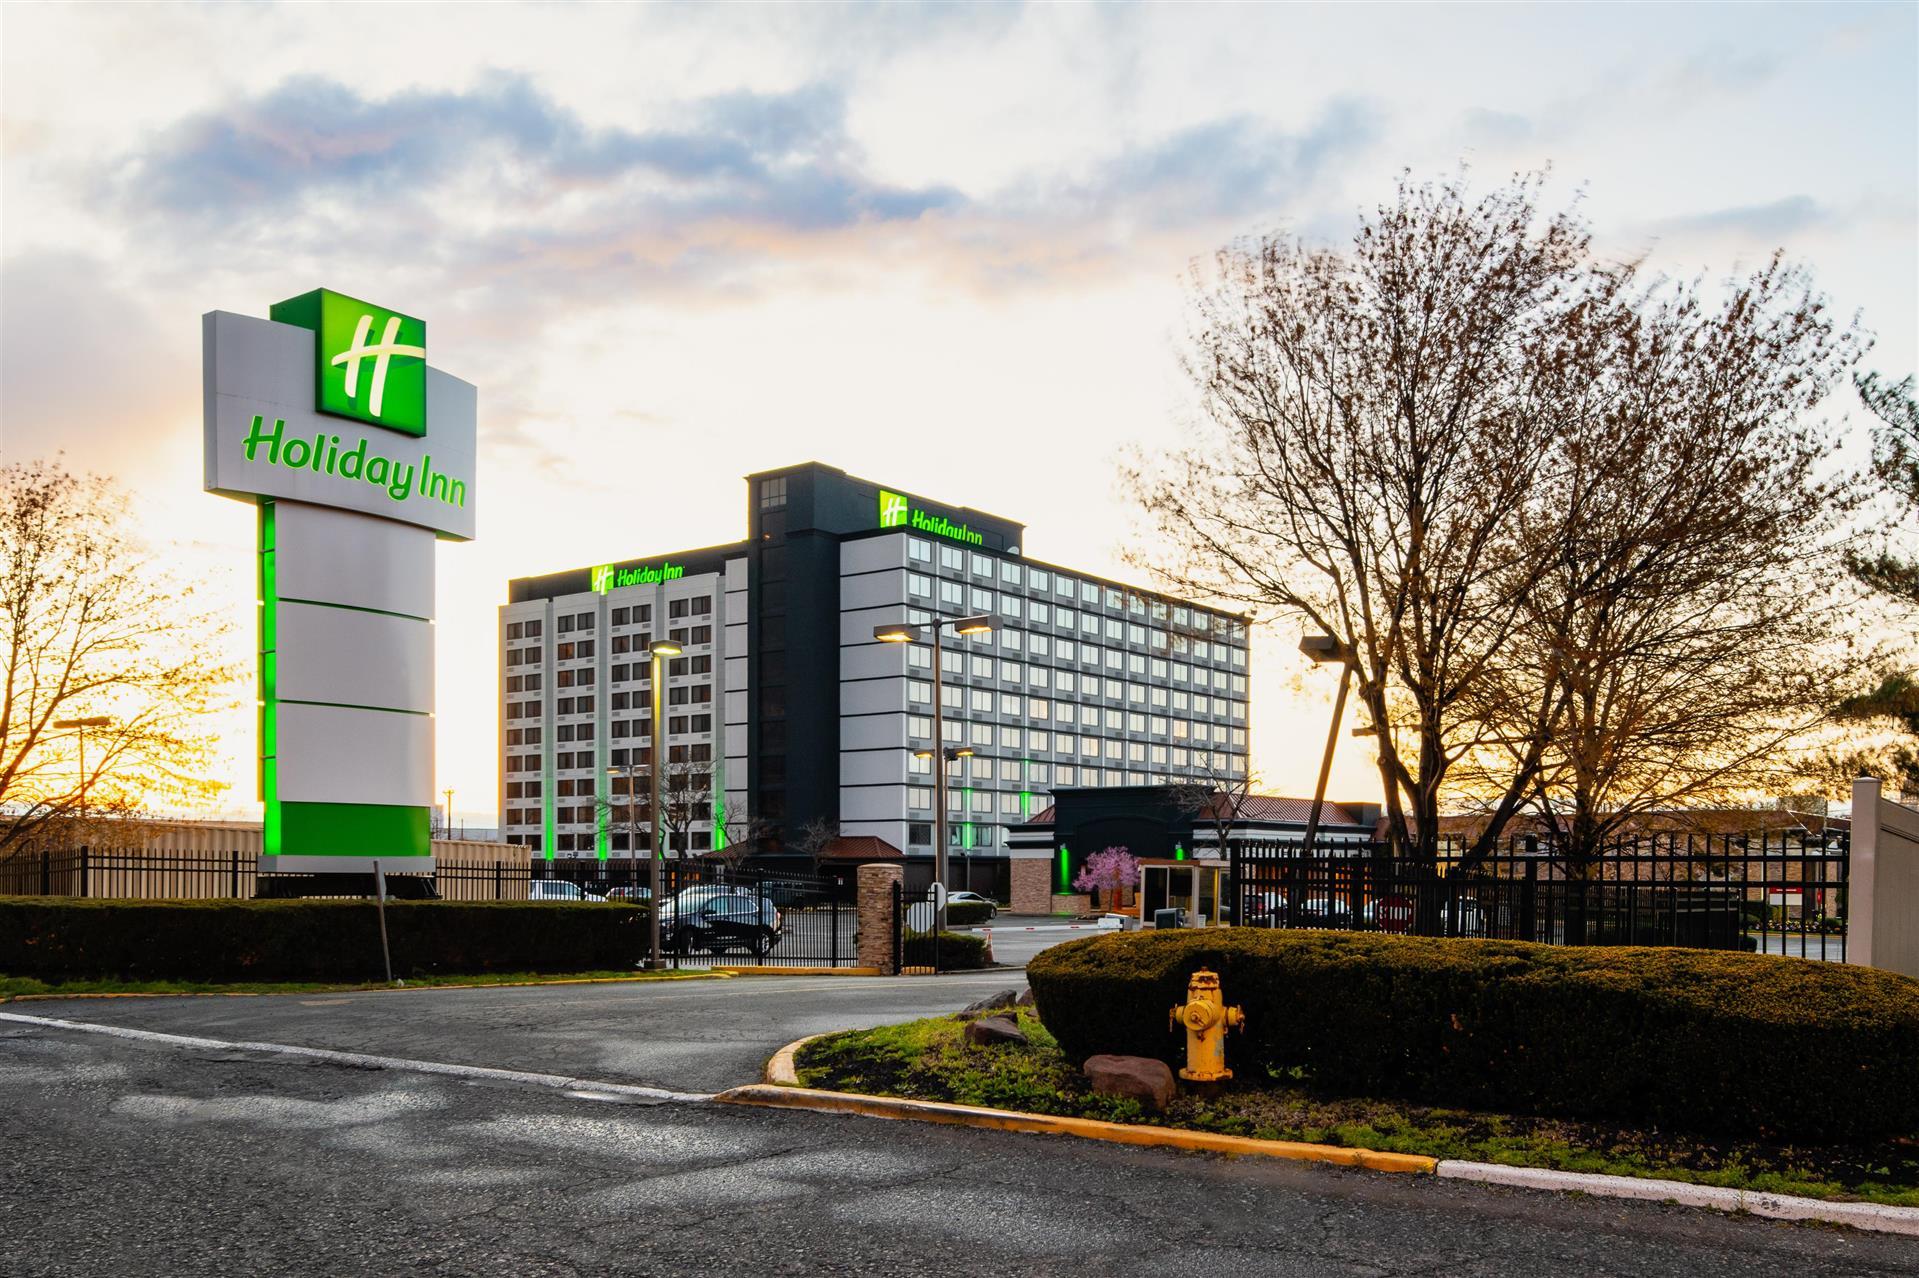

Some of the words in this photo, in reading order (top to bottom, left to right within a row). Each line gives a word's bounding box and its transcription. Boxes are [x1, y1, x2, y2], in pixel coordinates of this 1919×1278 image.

[242, 416, 414, 501] Holiday
[418, 455, 466, 508] Inn
[962, 525, 983, 545] Inn
[617, 566, 663, 585] Holiday
[663, 562, 684, 580] Inn
